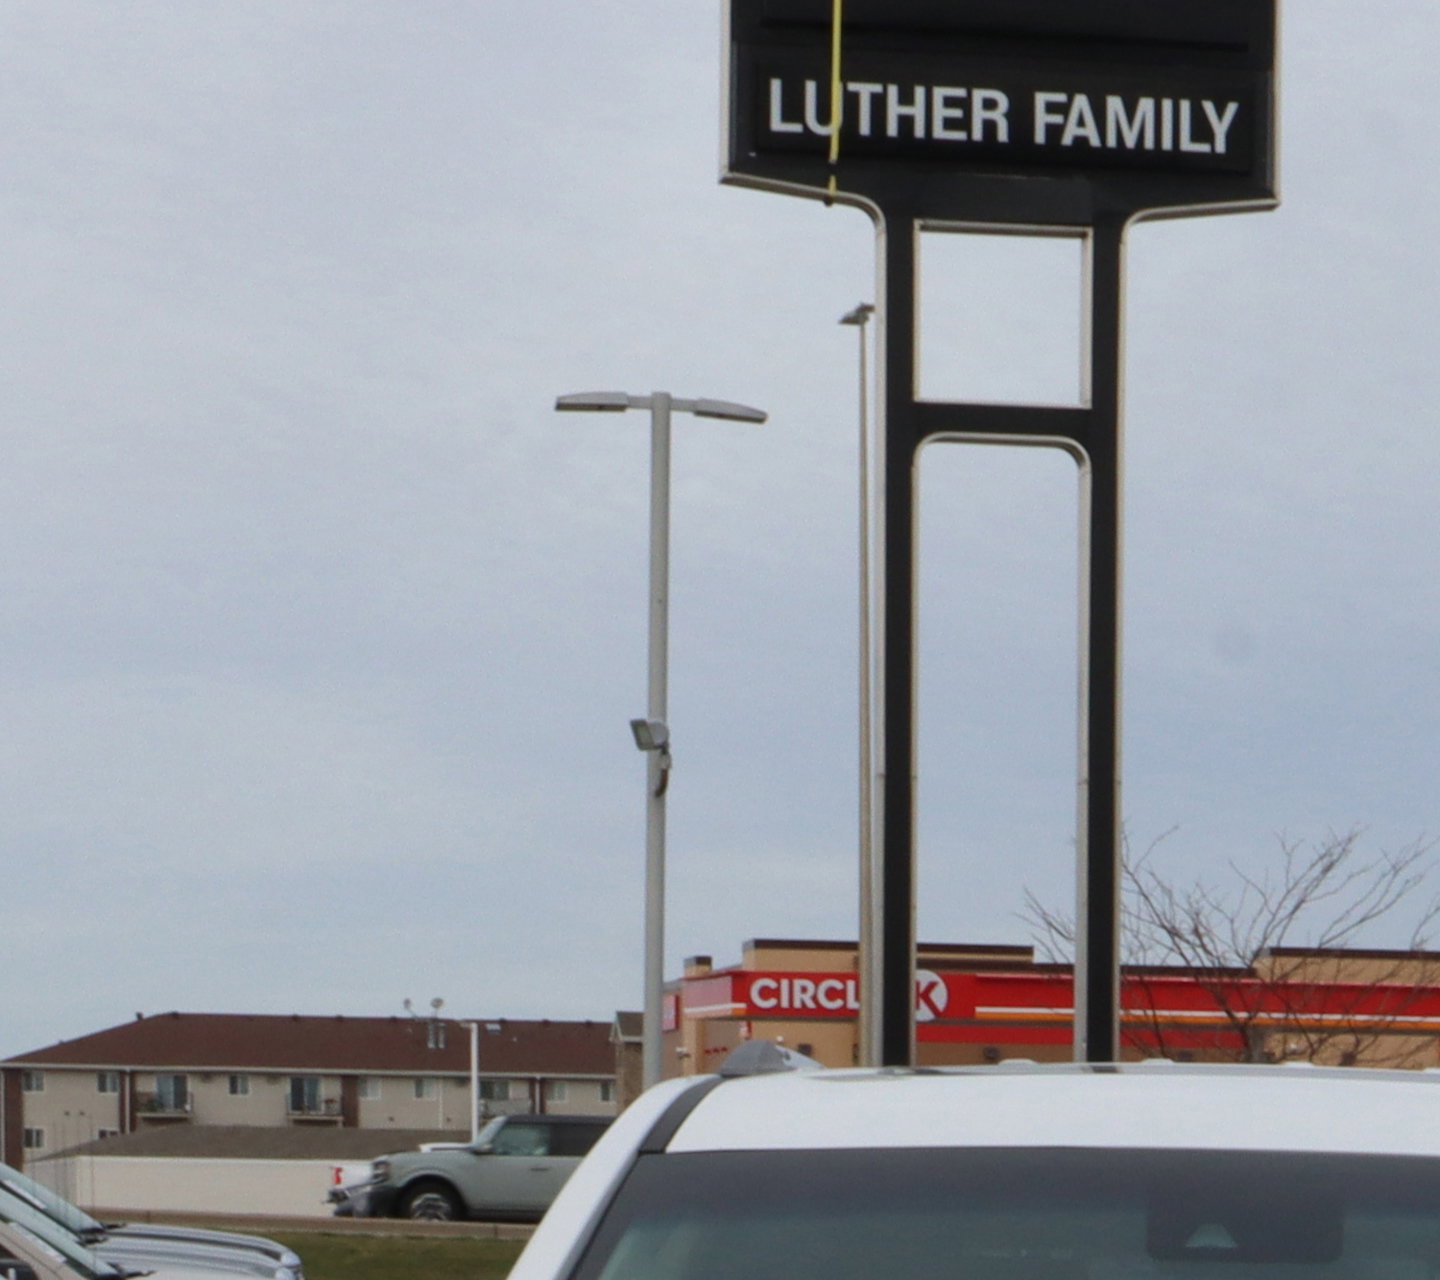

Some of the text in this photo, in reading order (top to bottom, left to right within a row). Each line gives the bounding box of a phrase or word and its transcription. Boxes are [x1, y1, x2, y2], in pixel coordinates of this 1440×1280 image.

[769, 78, 1239, 155] LUTHER FAMILY
[749, 977, 861, 1010] CIRCL
